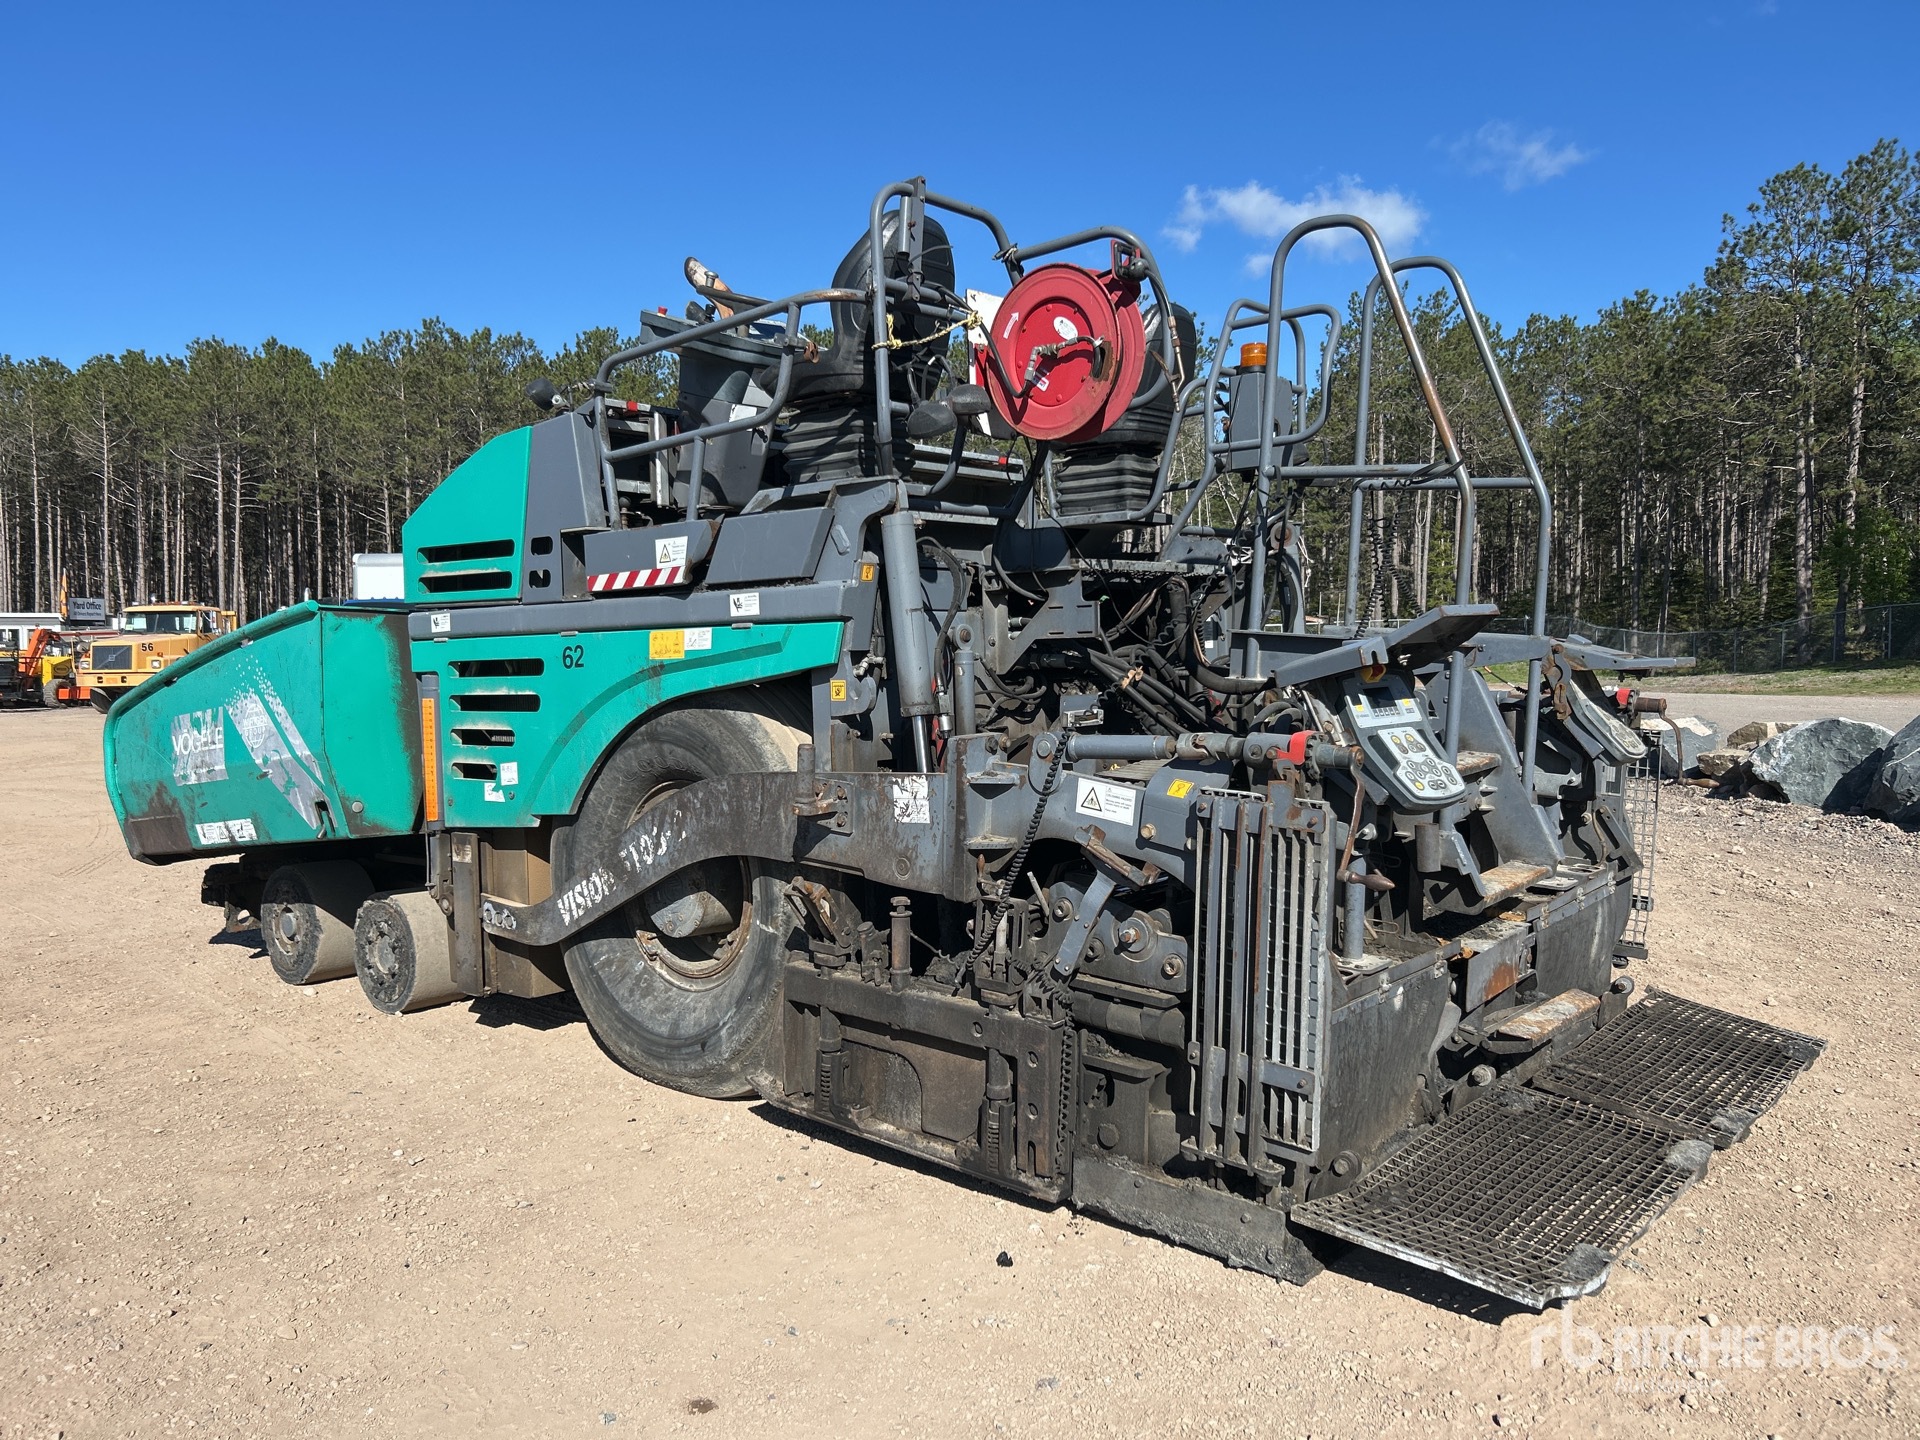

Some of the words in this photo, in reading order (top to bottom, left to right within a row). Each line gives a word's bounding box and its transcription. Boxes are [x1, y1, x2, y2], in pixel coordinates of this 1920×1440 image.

[73, 601, 86, 610] Yard
[86, 601, 102, 611] Office
[141, 642, 154, 652] 56
[562, 644, 585, 670] 62
